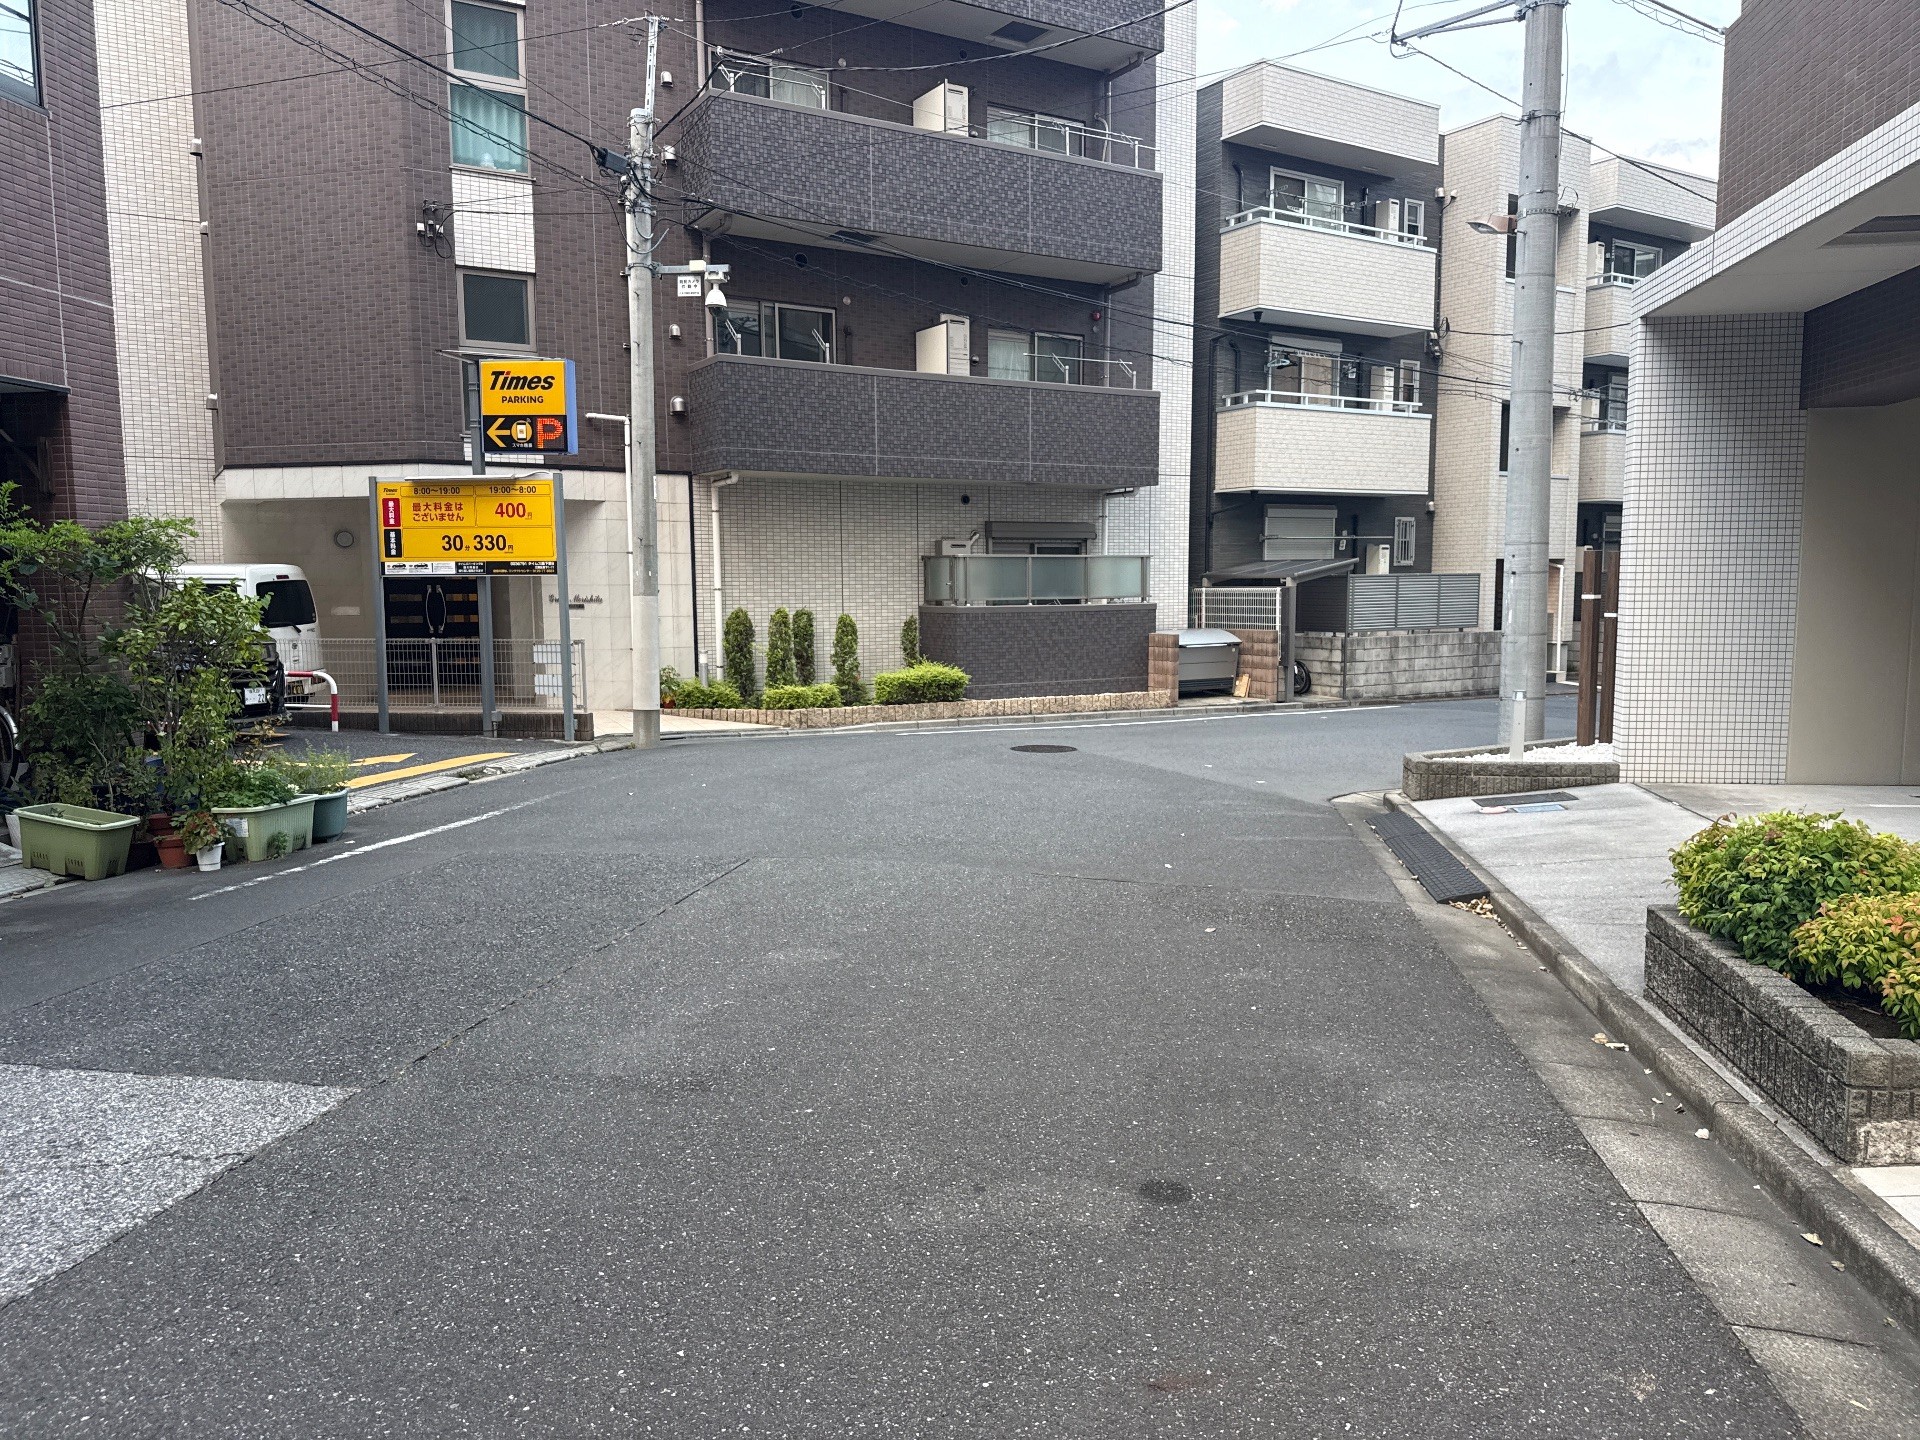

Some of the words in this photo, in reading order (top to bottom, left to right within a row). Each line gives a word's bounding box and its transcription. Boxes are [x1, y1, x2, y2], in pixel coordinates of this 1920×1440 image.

[489, 370, 555, 391] Times
[501, 395, 544, 404] PARKING
[536, 417, 563, 449] P
[412, 501, 464, 512] 最大料金は
[412, 512, 465, 522] ございません
